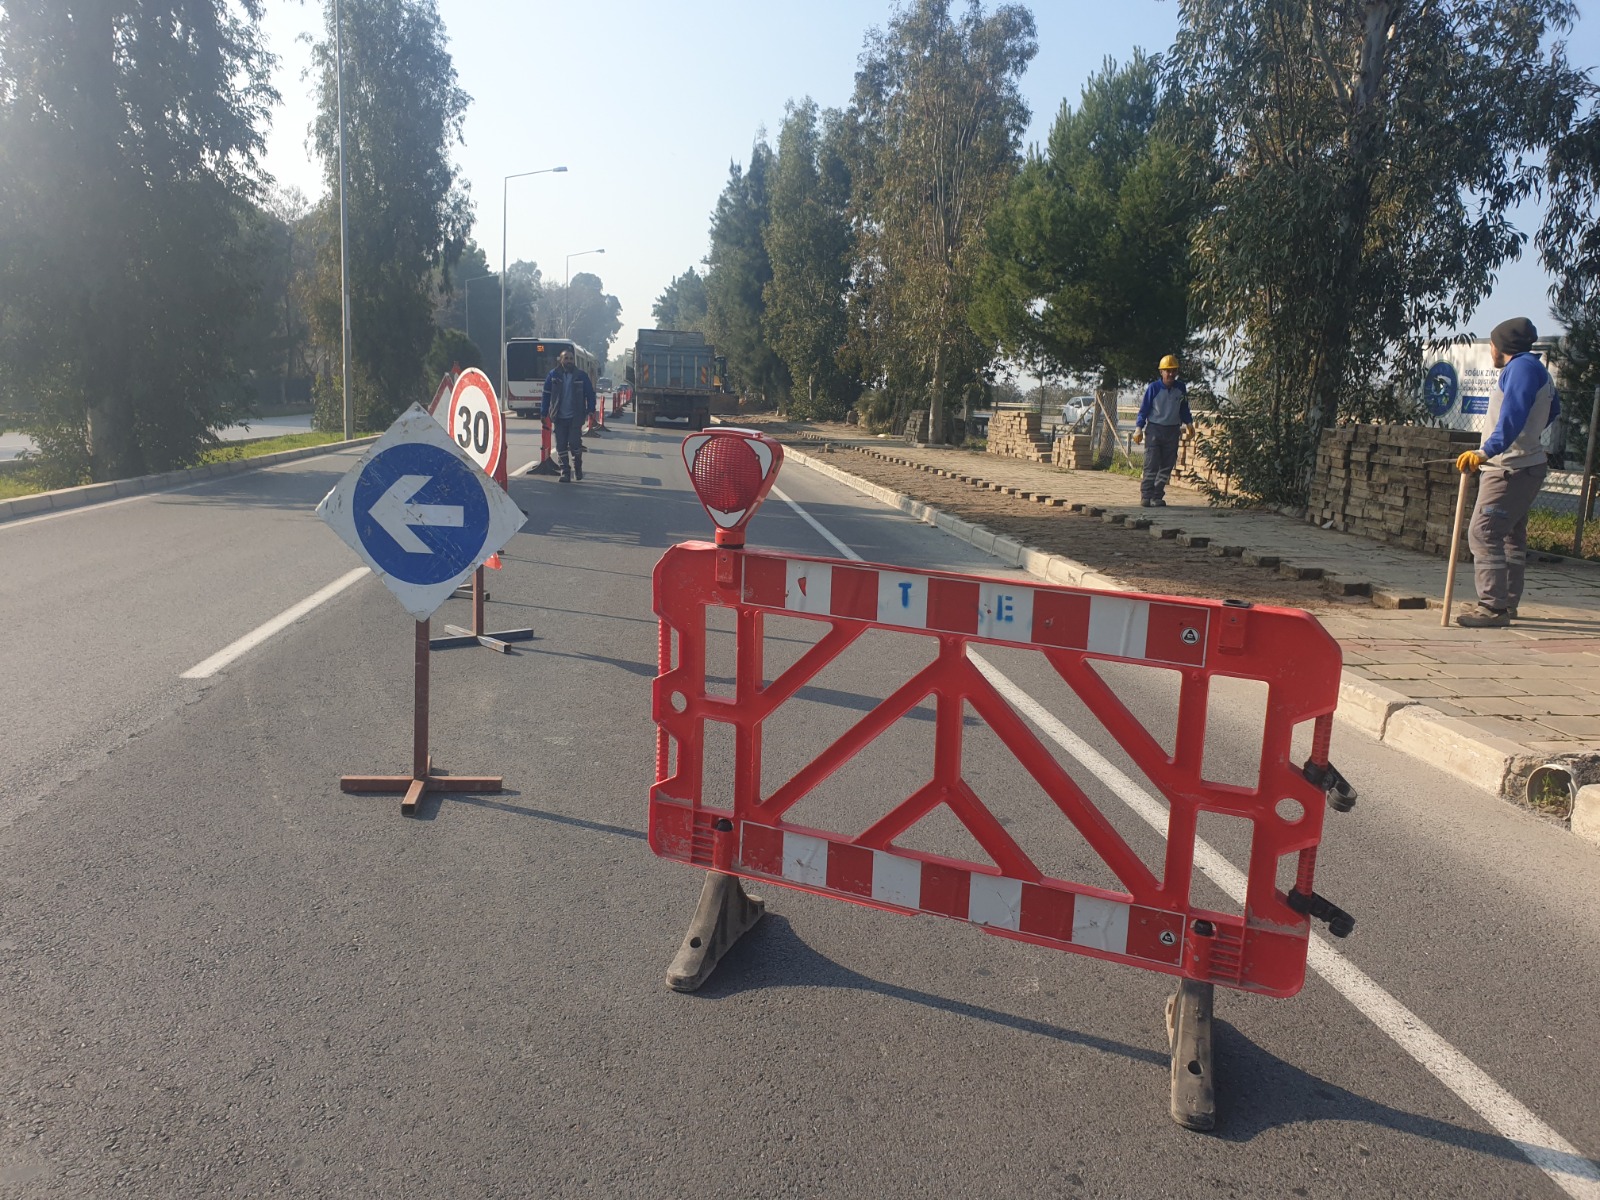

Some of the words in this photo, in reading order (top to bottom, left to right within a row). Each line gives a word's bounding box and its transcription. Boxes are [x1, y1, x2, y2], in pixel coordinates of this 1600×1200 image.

[1464, 368, 1484, 377] SOĞUK
[457, 405, 490, 455] 30
[898, 582, 912, 608] T
